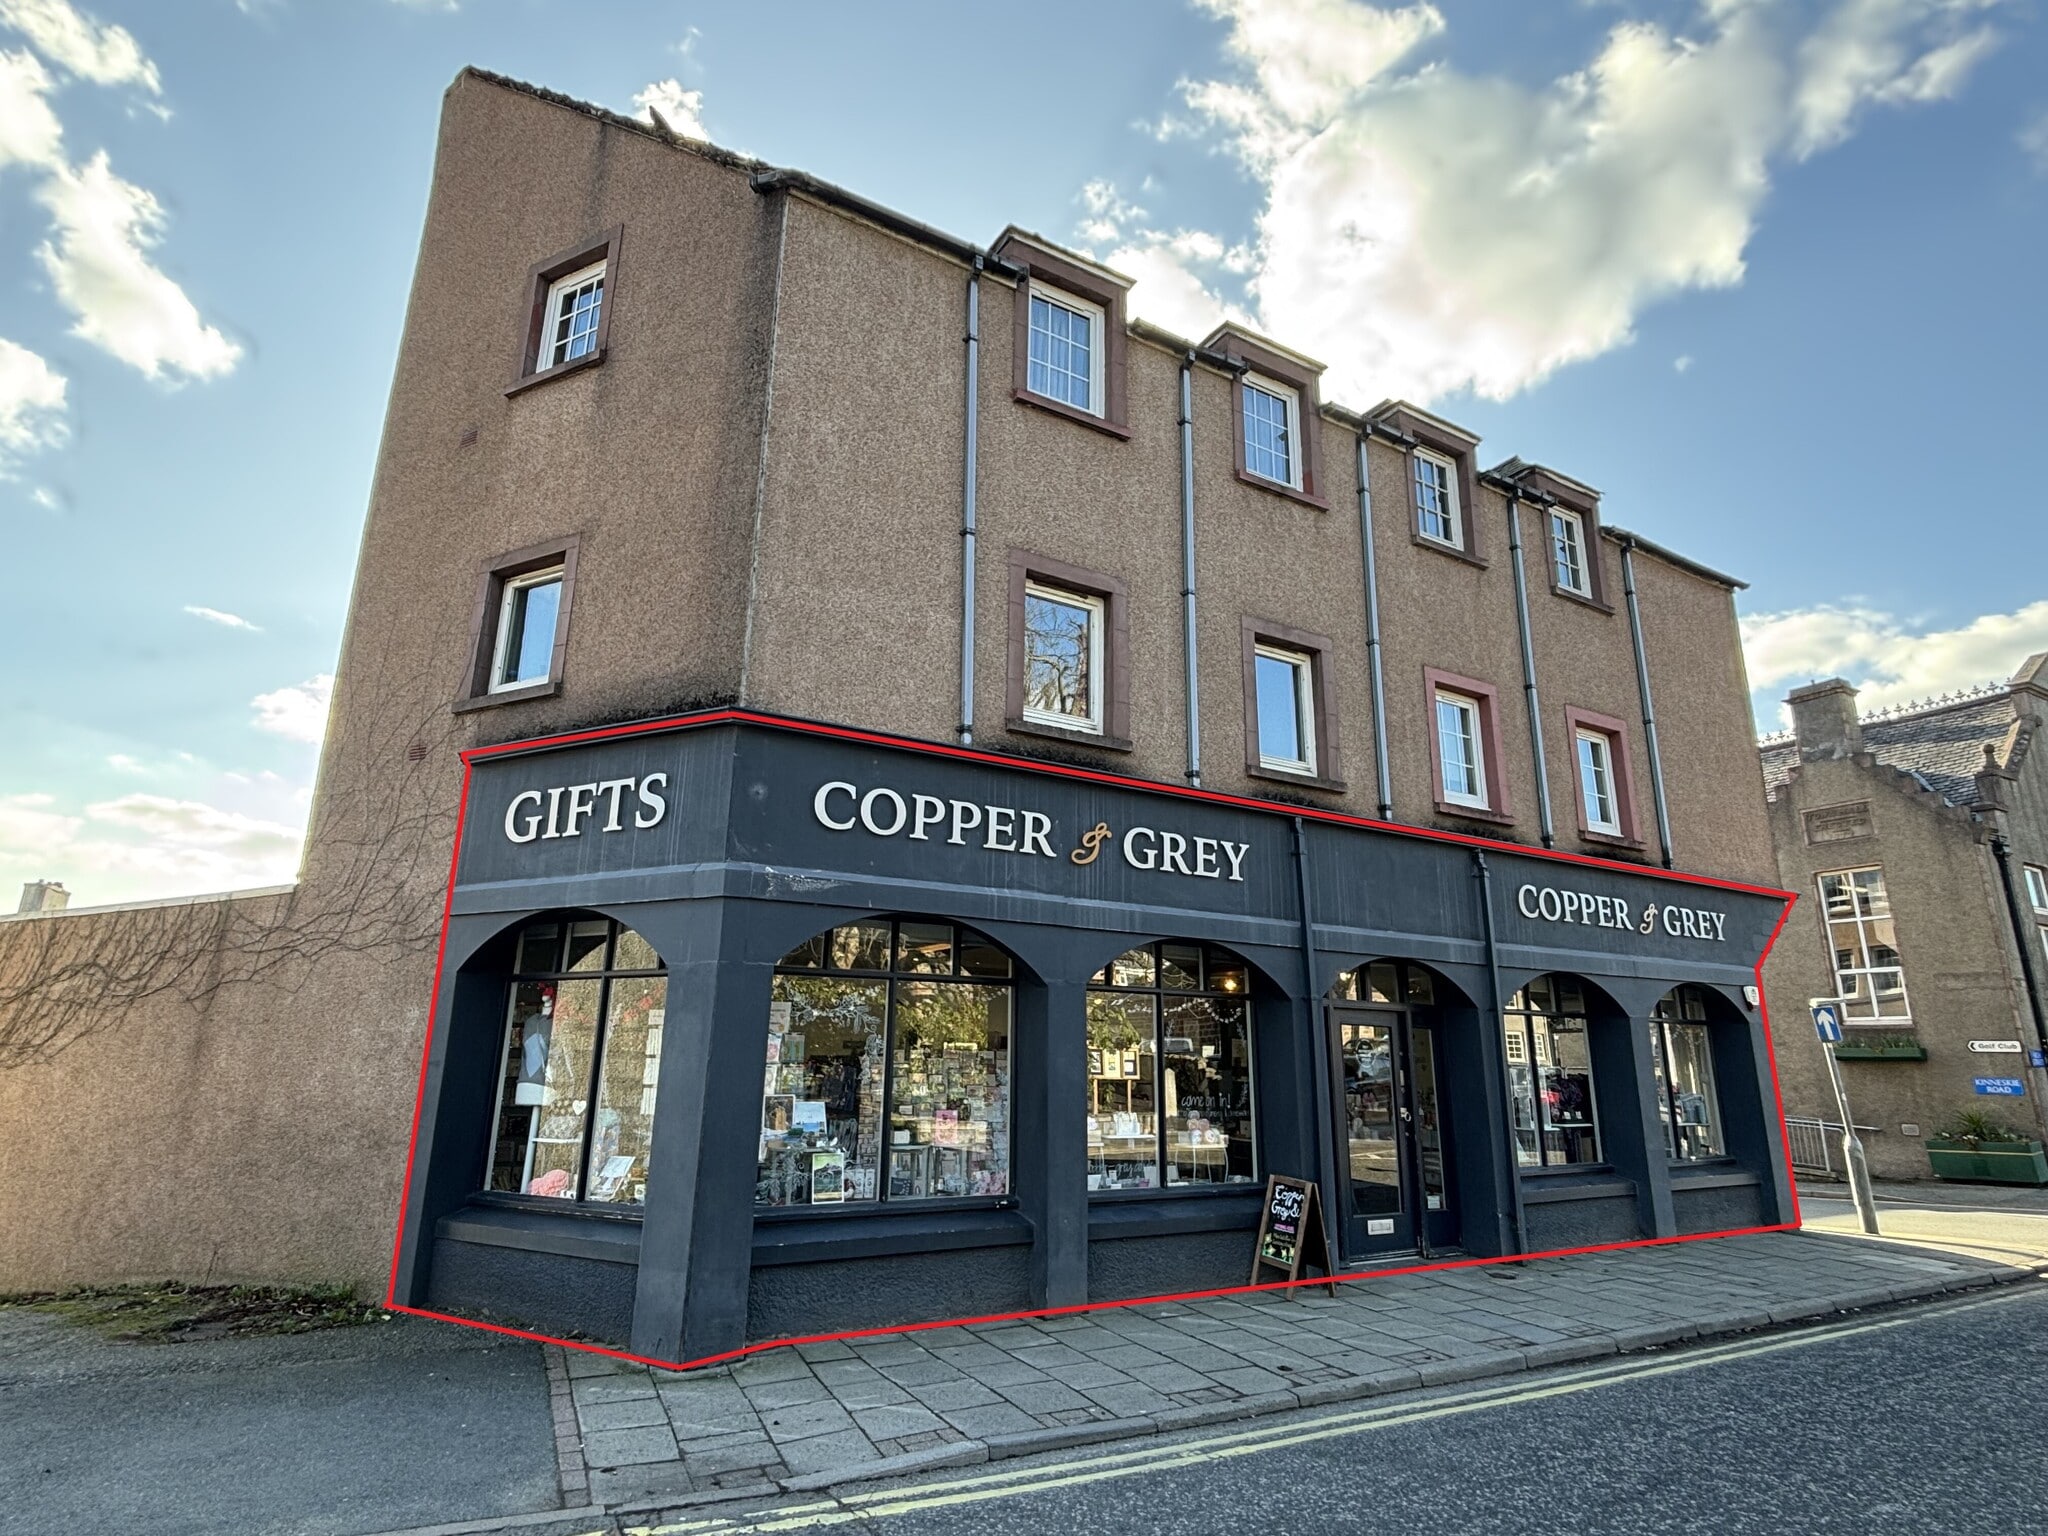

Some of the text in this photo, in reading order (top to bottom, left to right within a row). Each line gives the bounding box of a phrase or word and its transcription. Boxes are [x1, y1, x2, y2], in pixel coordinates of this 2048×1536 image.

[504, 772, 667, 843] GIFTS
[813, 781, 1057, 858] COPPER
[1122, 826, 1250, 881] GREY
[1518, 884, 1634, 931] COPPER
[1662, 905, 1726, 941] GREY
[1977, 1042, 2018, 1050] Golf Club
[1181, 1094, 1204, 1107] come
[1986, 1086, 2012, 1094] ROAD
